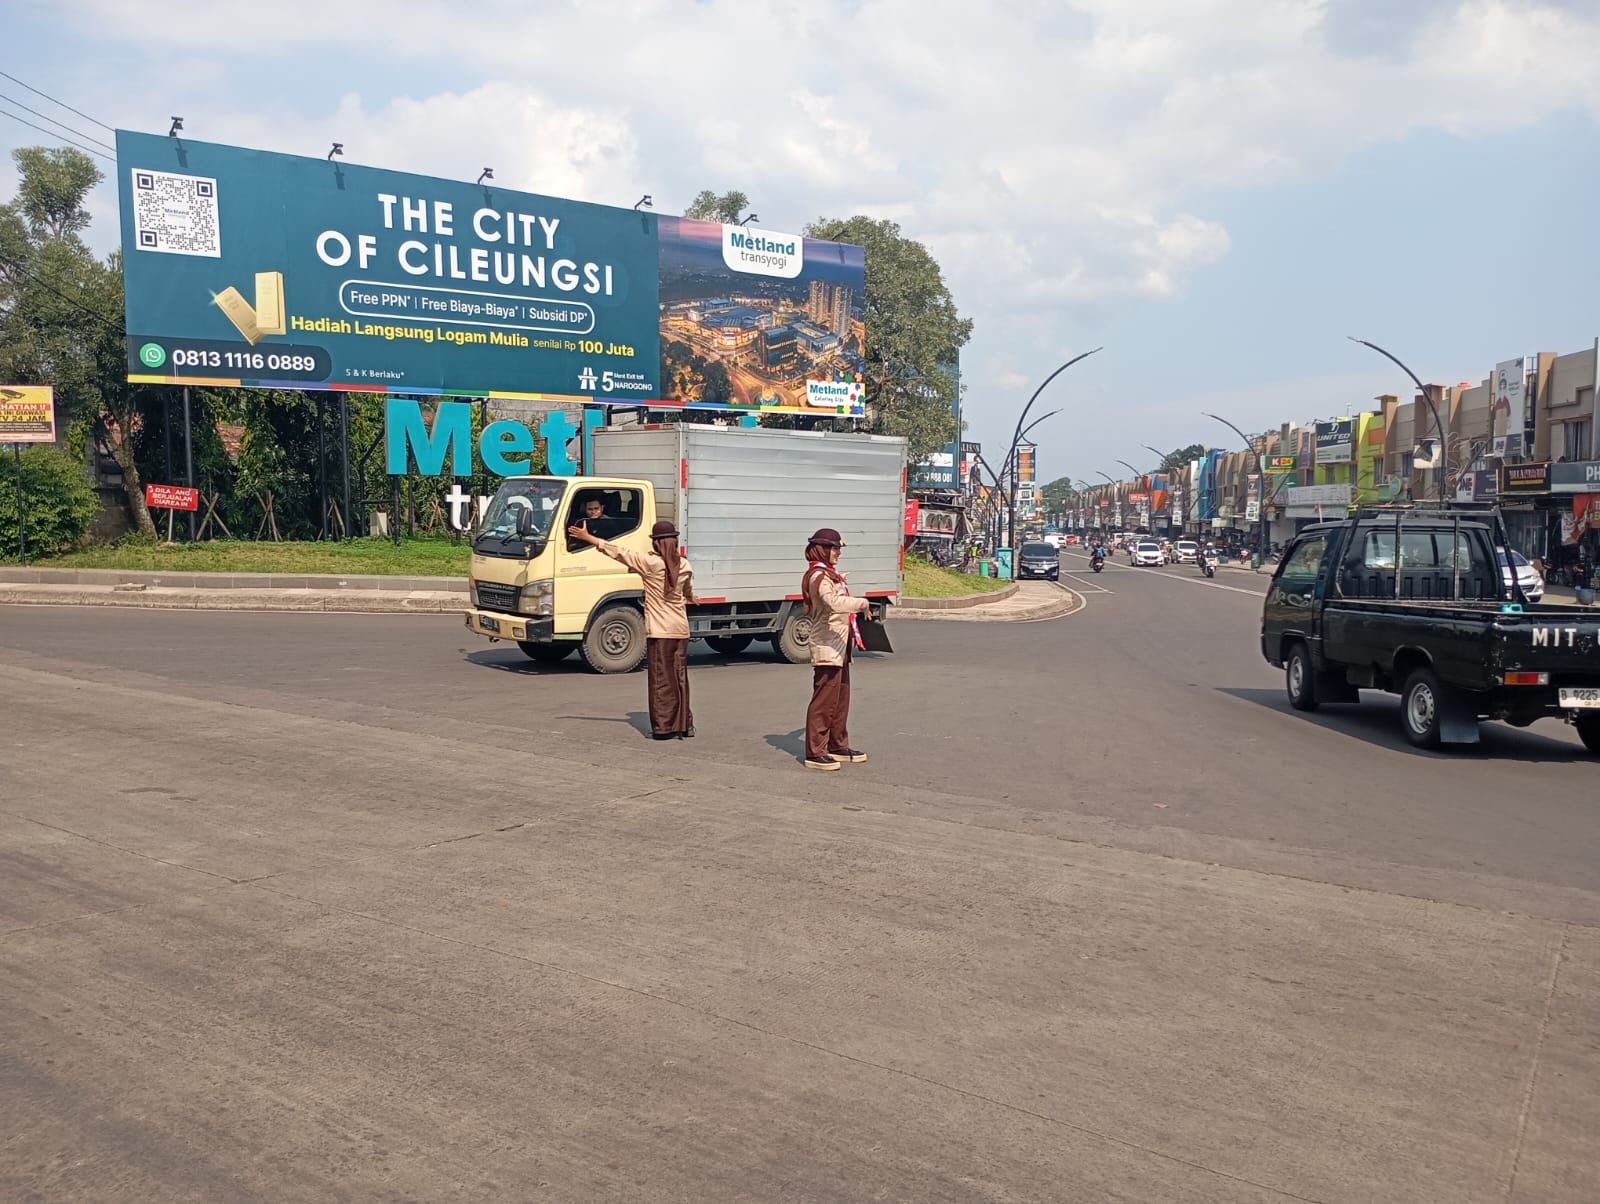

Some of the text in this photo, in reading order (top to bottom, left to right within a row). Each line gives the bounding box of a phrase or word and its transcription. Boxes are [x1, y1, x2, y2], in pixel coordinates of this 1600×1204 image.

[378, 193, 560, 250] THE CITY
[731, 232, 795, 256] Metland
[316, 230, 614, 296] OF CILEUNGSI
[740, 250, 787, 270] transyogi
[350, 290, 378, 304] Free
[422, 297, 448, 311] Free
[530, 306, 568, 322] Subsidi
[291, 316, 634, 356] Hadiah Langsung Logam Mulia senilai Rp 100 Juta
[172, 350, 316, 371] 0813 1116 0889
[346, 368, 351, 376] S
[354, 369, 359, 377] &
[602, 371, 614, 392] 5
[614, 382, 652, 390] NAROGONG
[810, 384, 848, 395] Metland
[152, 492, 192, 502] BERJUALAN
